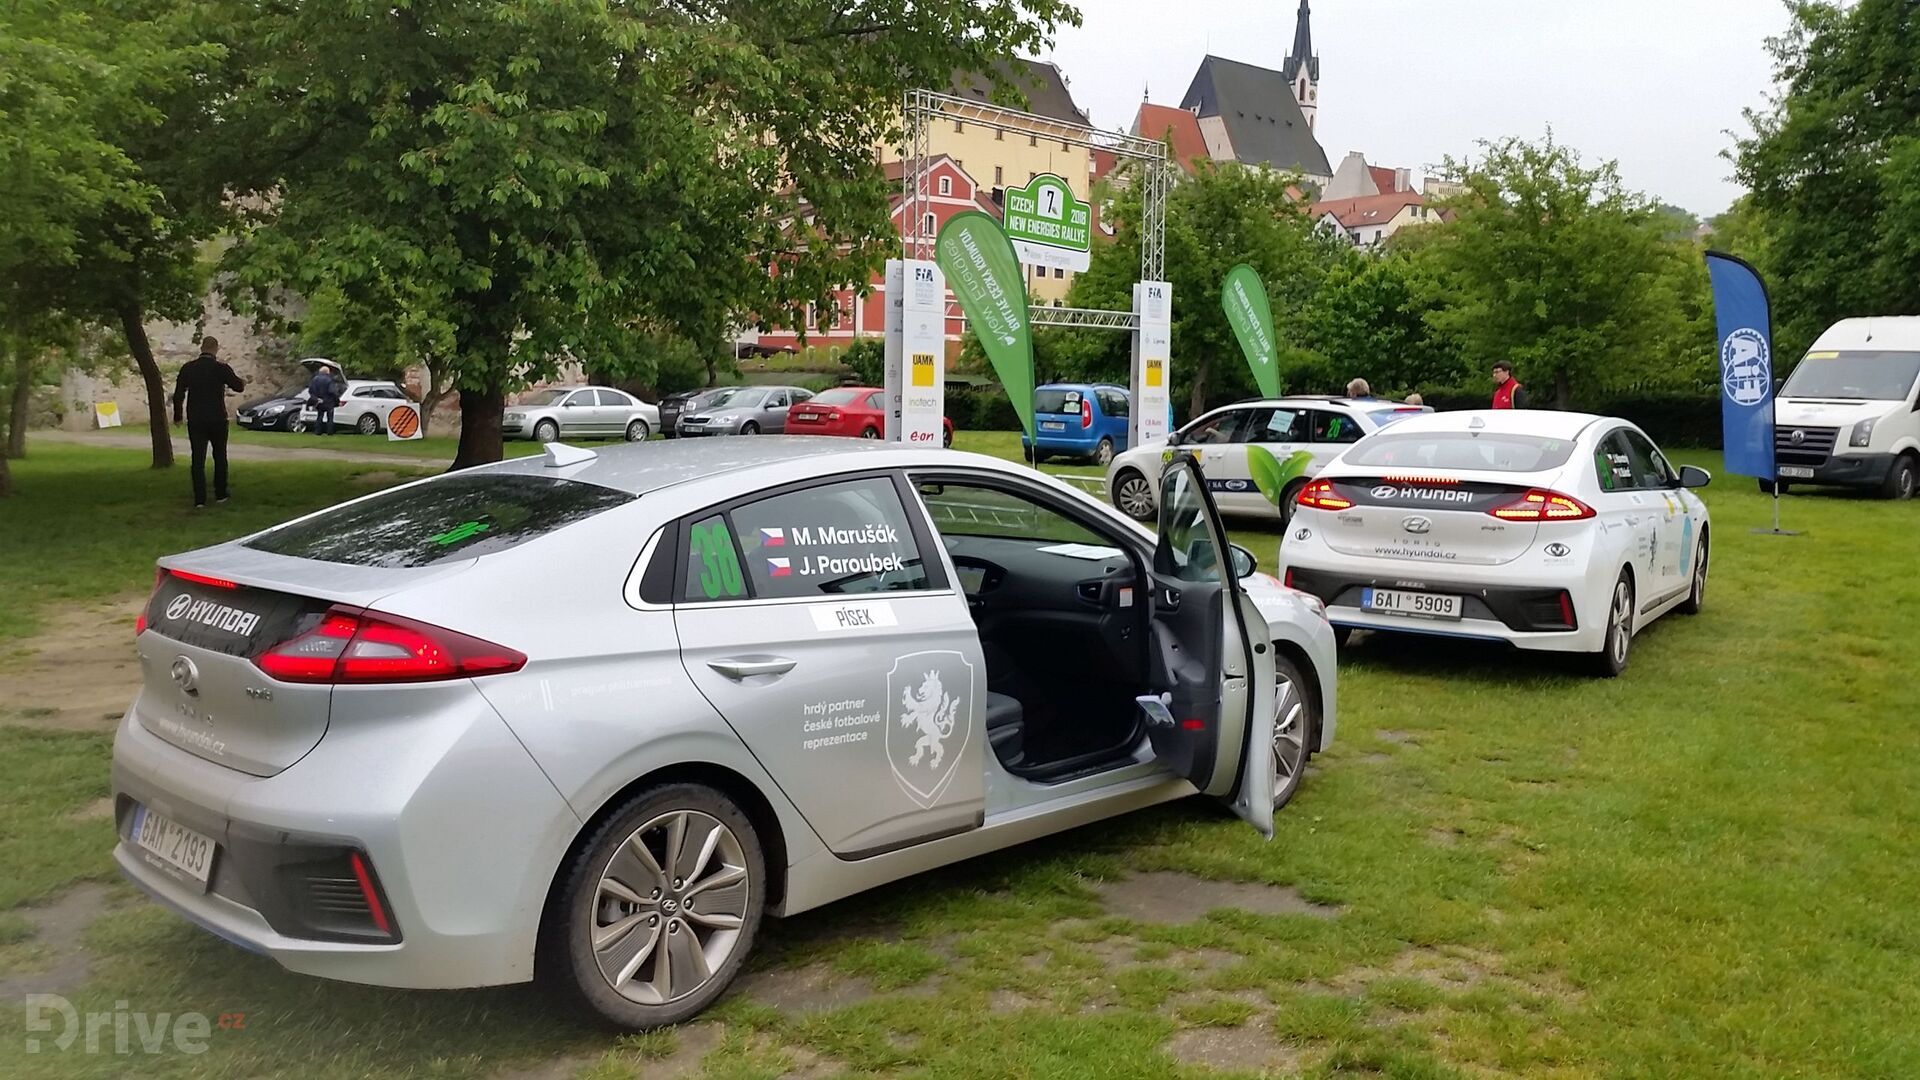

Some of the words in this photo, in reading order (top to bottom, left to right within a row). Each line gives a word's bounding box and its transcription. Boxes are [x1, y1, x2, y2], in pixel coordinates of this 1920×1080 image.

[1010, 195, 1035, 214] CZECH
[1046, 190, 1055, 214] 7
[1071, 209, 1087, 225] 2018
[1009, 215, 1026, 232] NEW
[1027, 219, 1060, 239] ENERGIES
[1061, 225, 1086, 244] RALLYE
[912, 354, 935, 366] UAMK
[1400, 488, 1473, 503] HYUNDAI
[791, 526, 817, 546] M.
[818, 524, 898, 546] Marušák
[1375, 546, 1457, 560] www.hyundai.cz
[799, 559, 816, 576] J.
[817, 553, 905, 575] Paroubek
[1375, 592, 1401, 608] 6AI
[1415, 595, 1453, 613] 5909
[185, 600, 261, 637] HYUNDAI
[835, 606, 875, 628] PÍSEK
[803, 703, 827, 715] hrdý
[828, 698, 866, 713] partner
[803, 718, 832, 732] české
[834, 711, 881, 728] fotbalové
[803, 731, 868, 750] reprezentace
[170, 828, 207, 872] 2193
